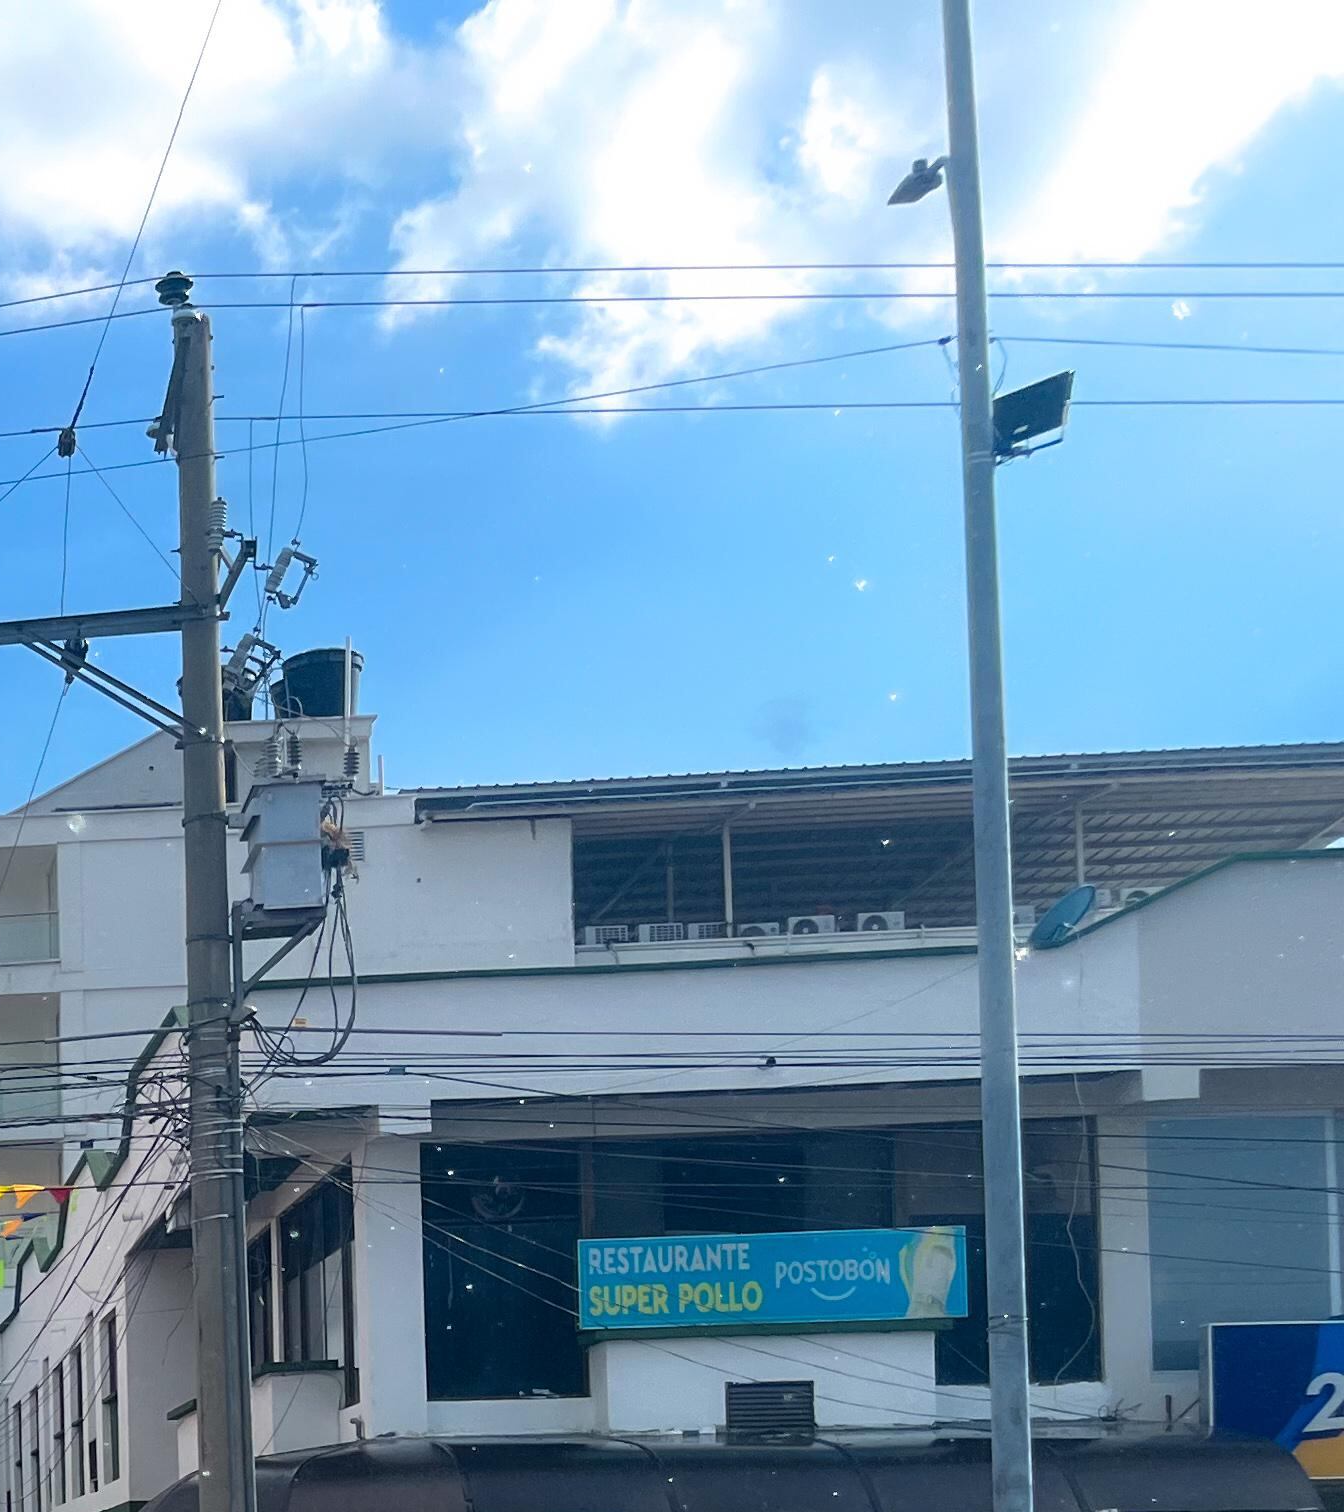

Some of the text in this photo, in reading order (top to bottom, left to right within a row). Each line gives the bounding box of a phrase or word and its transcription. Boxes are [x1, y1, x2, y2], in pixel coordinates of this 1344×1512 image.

[588, 1243, 751, 1275] RESTAURANTE
[588, 1280, 763, 1316] SUPER POLLO
